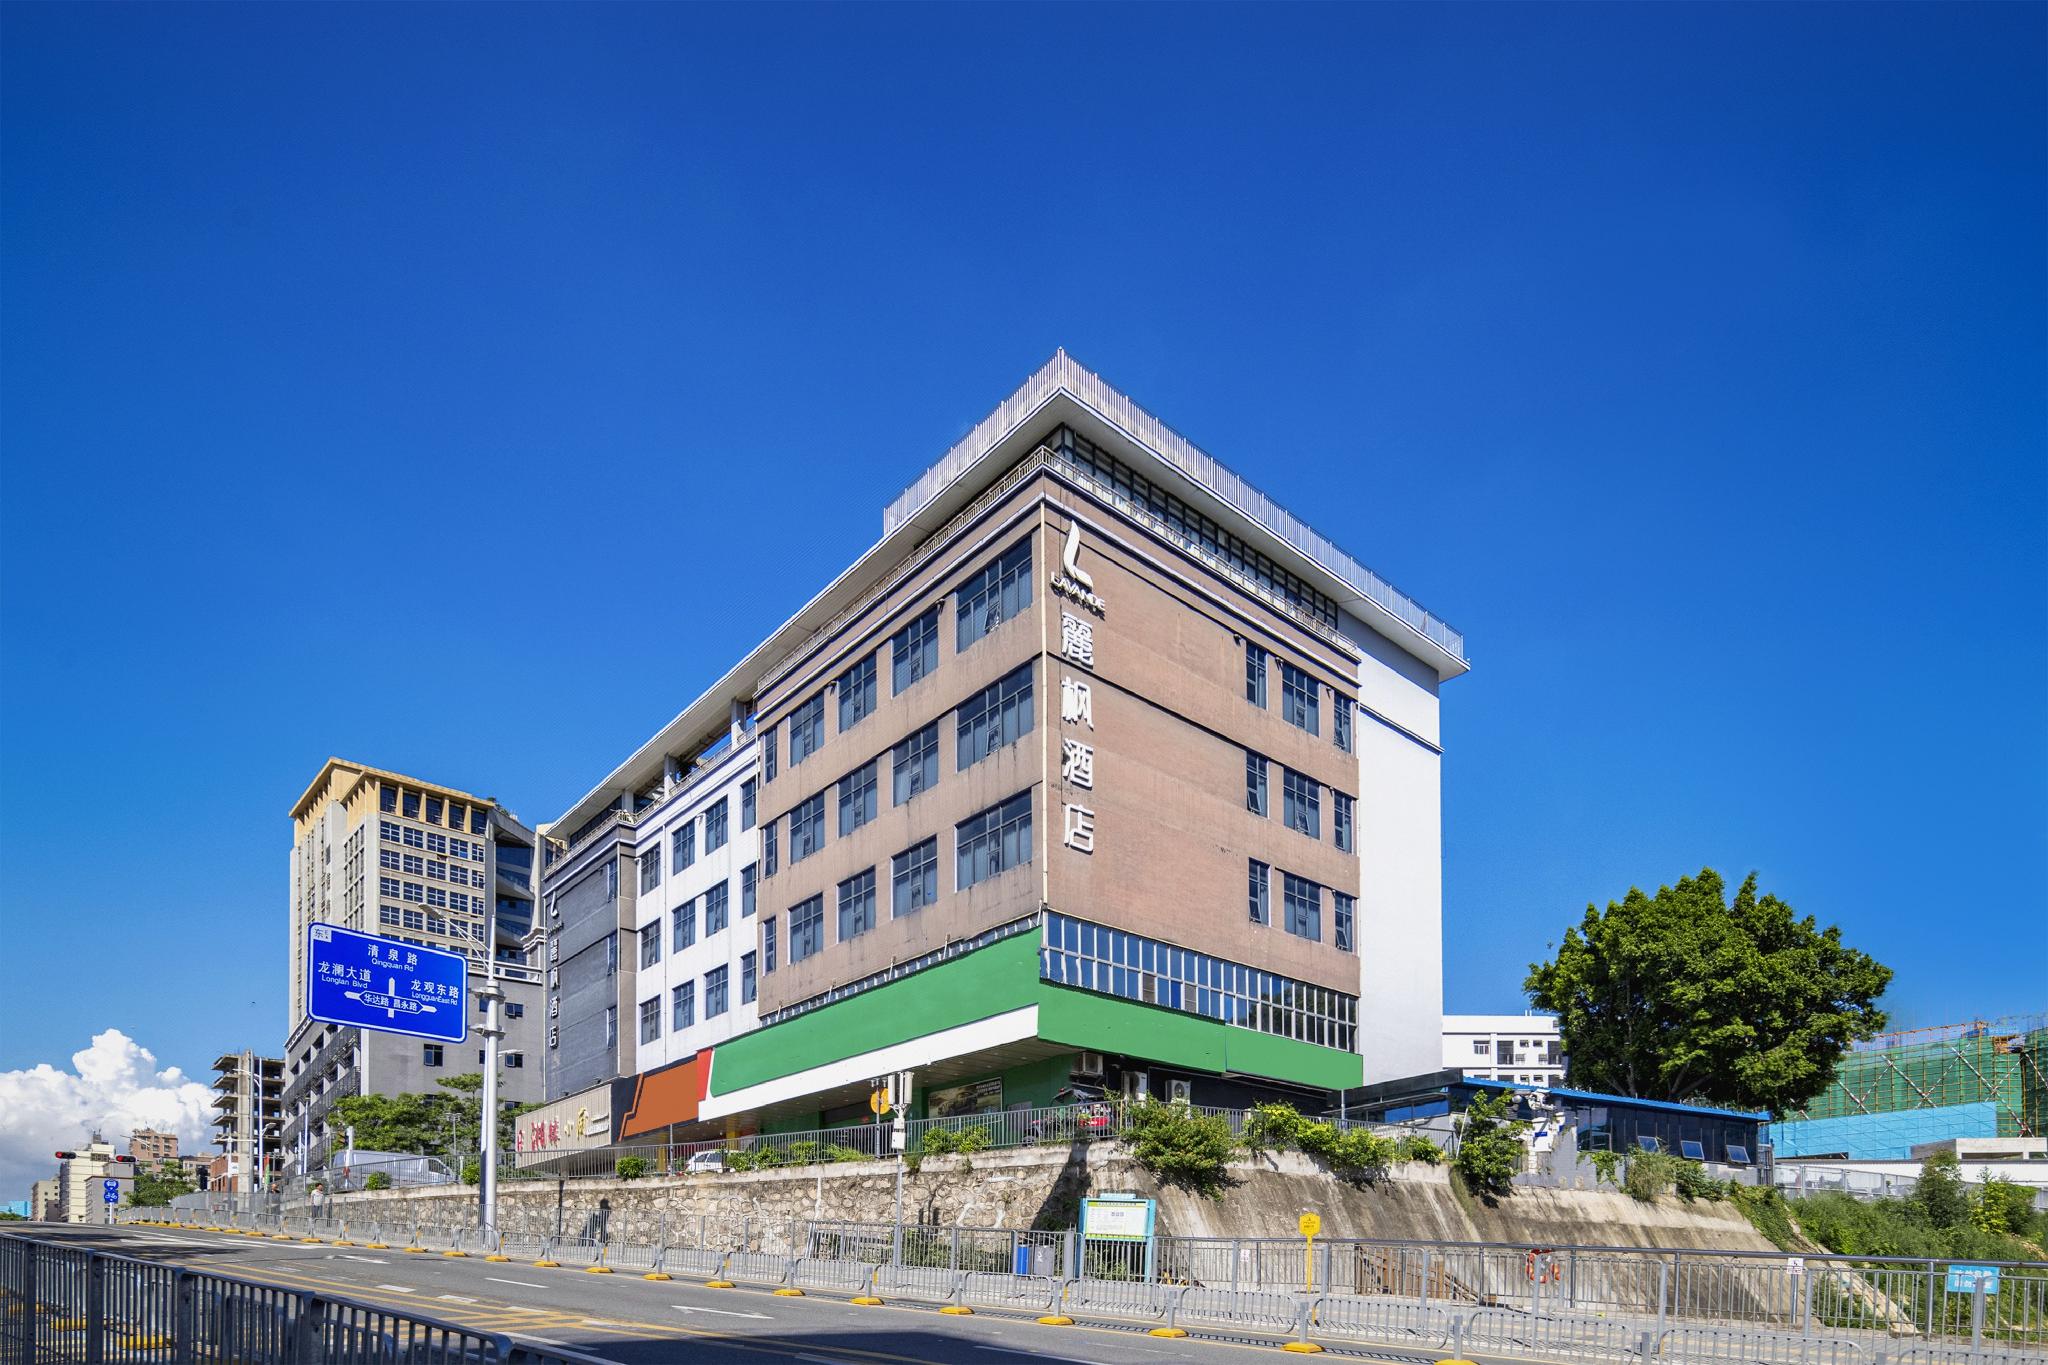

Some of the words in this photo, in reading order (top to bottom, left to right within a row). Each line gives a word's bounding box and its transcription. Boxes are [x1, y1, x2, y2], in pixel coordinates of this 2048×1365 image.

[368, 943, 418, 966] 清泉路
[318, 961, 371, 983] 龙澜大道
[404, 964, 414, 972] Rd
[321, 974, 350, 986] Longlan
[352, 980, 368, 989] Blvd
[411, 979, 459, 999] 龙观东路
